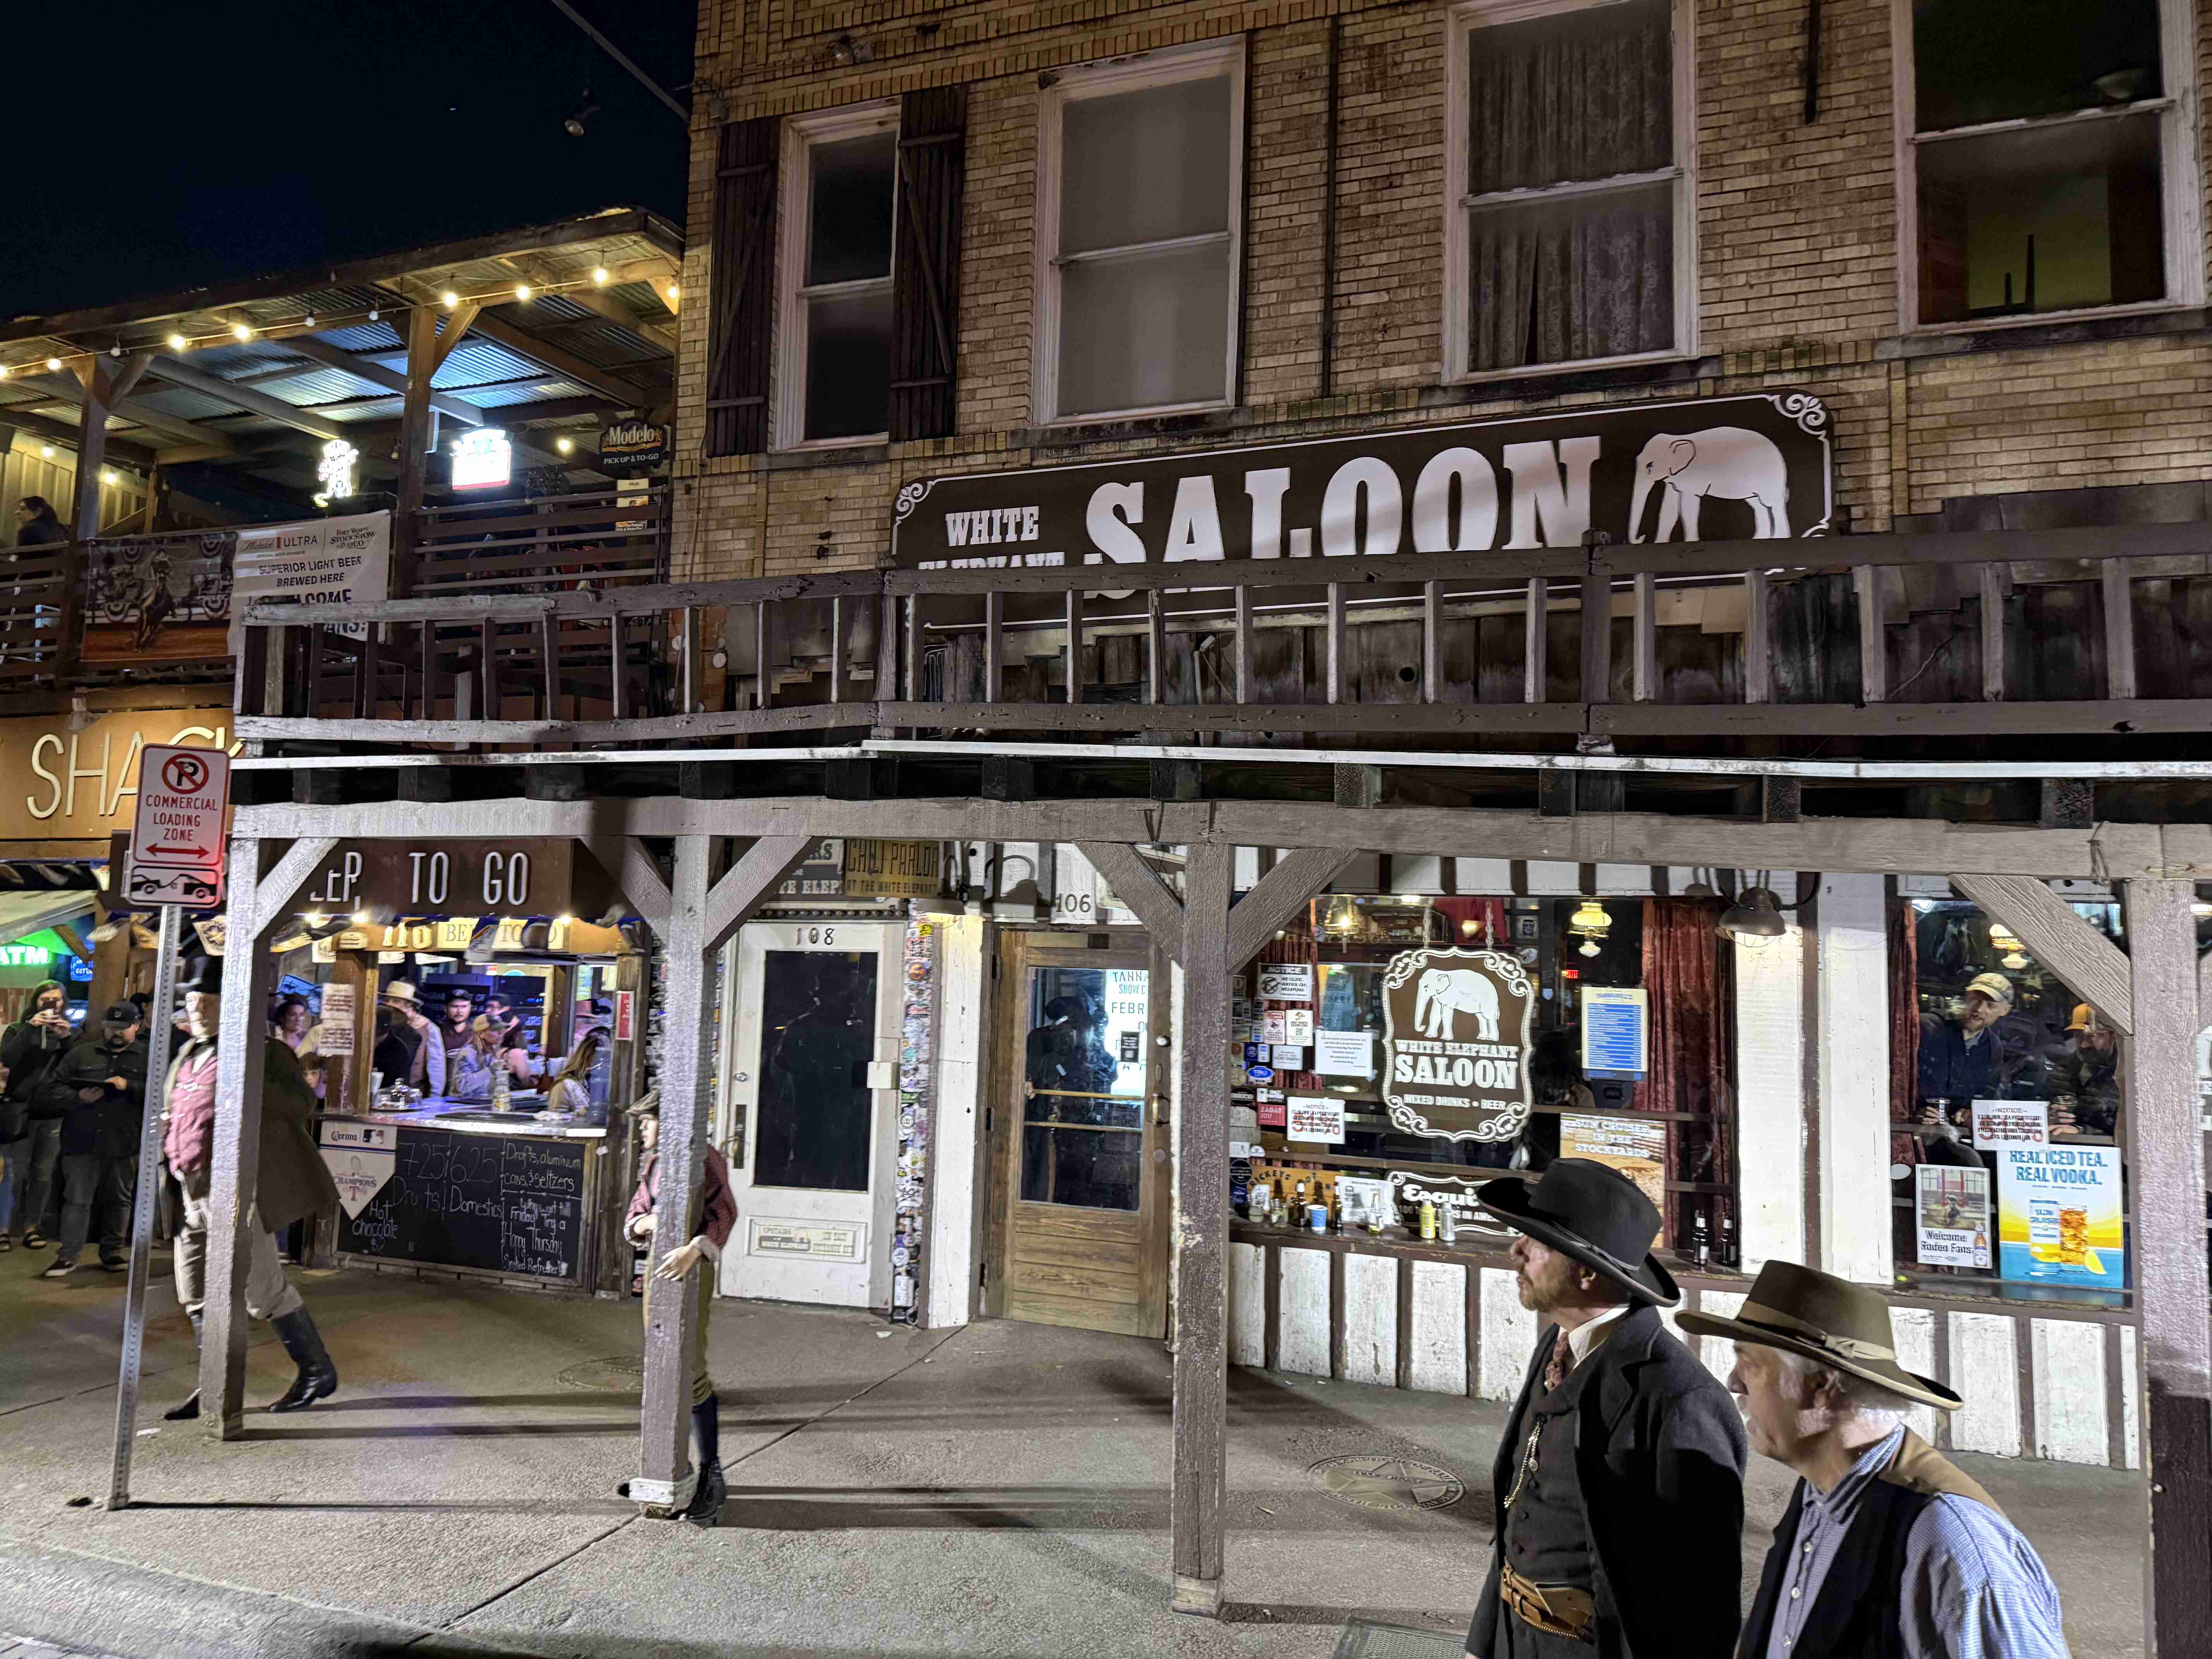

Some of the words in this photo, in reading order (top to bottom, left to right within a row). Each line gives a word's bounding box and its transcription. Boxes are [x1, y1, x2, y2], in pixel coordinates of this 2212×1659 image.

[610, 424, 654, 445] Modelo
[945, 506, 1039, 547] WHITE
[1084, 436, 1601, 599] SALOON
[283, 535, 318, 547] ULTRA
[259, 562, 306, 575] SUPERIOR
[309, 559, 335, 571] LIGHT
[339, 556, 362, 567] BEER
[277, 575, 317, 587] BREWED
[320, 572, 344, 584] HERE
[146, 795, 218, 811] COMMERCIAL
[153, 812, 201, 828] LOADING
[164, 828, 194, 841] ZONE
[409, 852, 448, 904] TO
[483, 852, 530, 905] GO
[802, 880, 843, 895] ELEP
[1055, 893, 1091, 913] 106
[797, 927, 835, 946] 108
[0, 946, 49, 965] ATM
[1395, 1039, 1443, 1054] WHITE
[1444, 1042, 1519, 1058] ELEPHANT
[1395, 1054, 1518, 1089] SALOON
[1404, 1094, 1434, 1105] MIXED
[1435, 1096, 1470, 1108] DRINKS
[1481, 1099, 1506, 1110] BEER
[397, 1142, 446, 1180] 7.25
[450, 1145, 498, 1183] 6.25
[540, 1148, 581, 1170] aluminum
[2010, 1151, 2043, 1164] REAL
[2046, 1151, 2075, 1165] ICED
[2016, 1166, 2050, 1182] REAL
[393, 1176, 440, 1212] Drats
[450, 1185, 503, 1218] Domestics
[369, 1200, 392, 1220] Hot
[1925, 1230, 1967, 1242] Welcome
[1921, 1241, 1949, 1252] Rodeo
